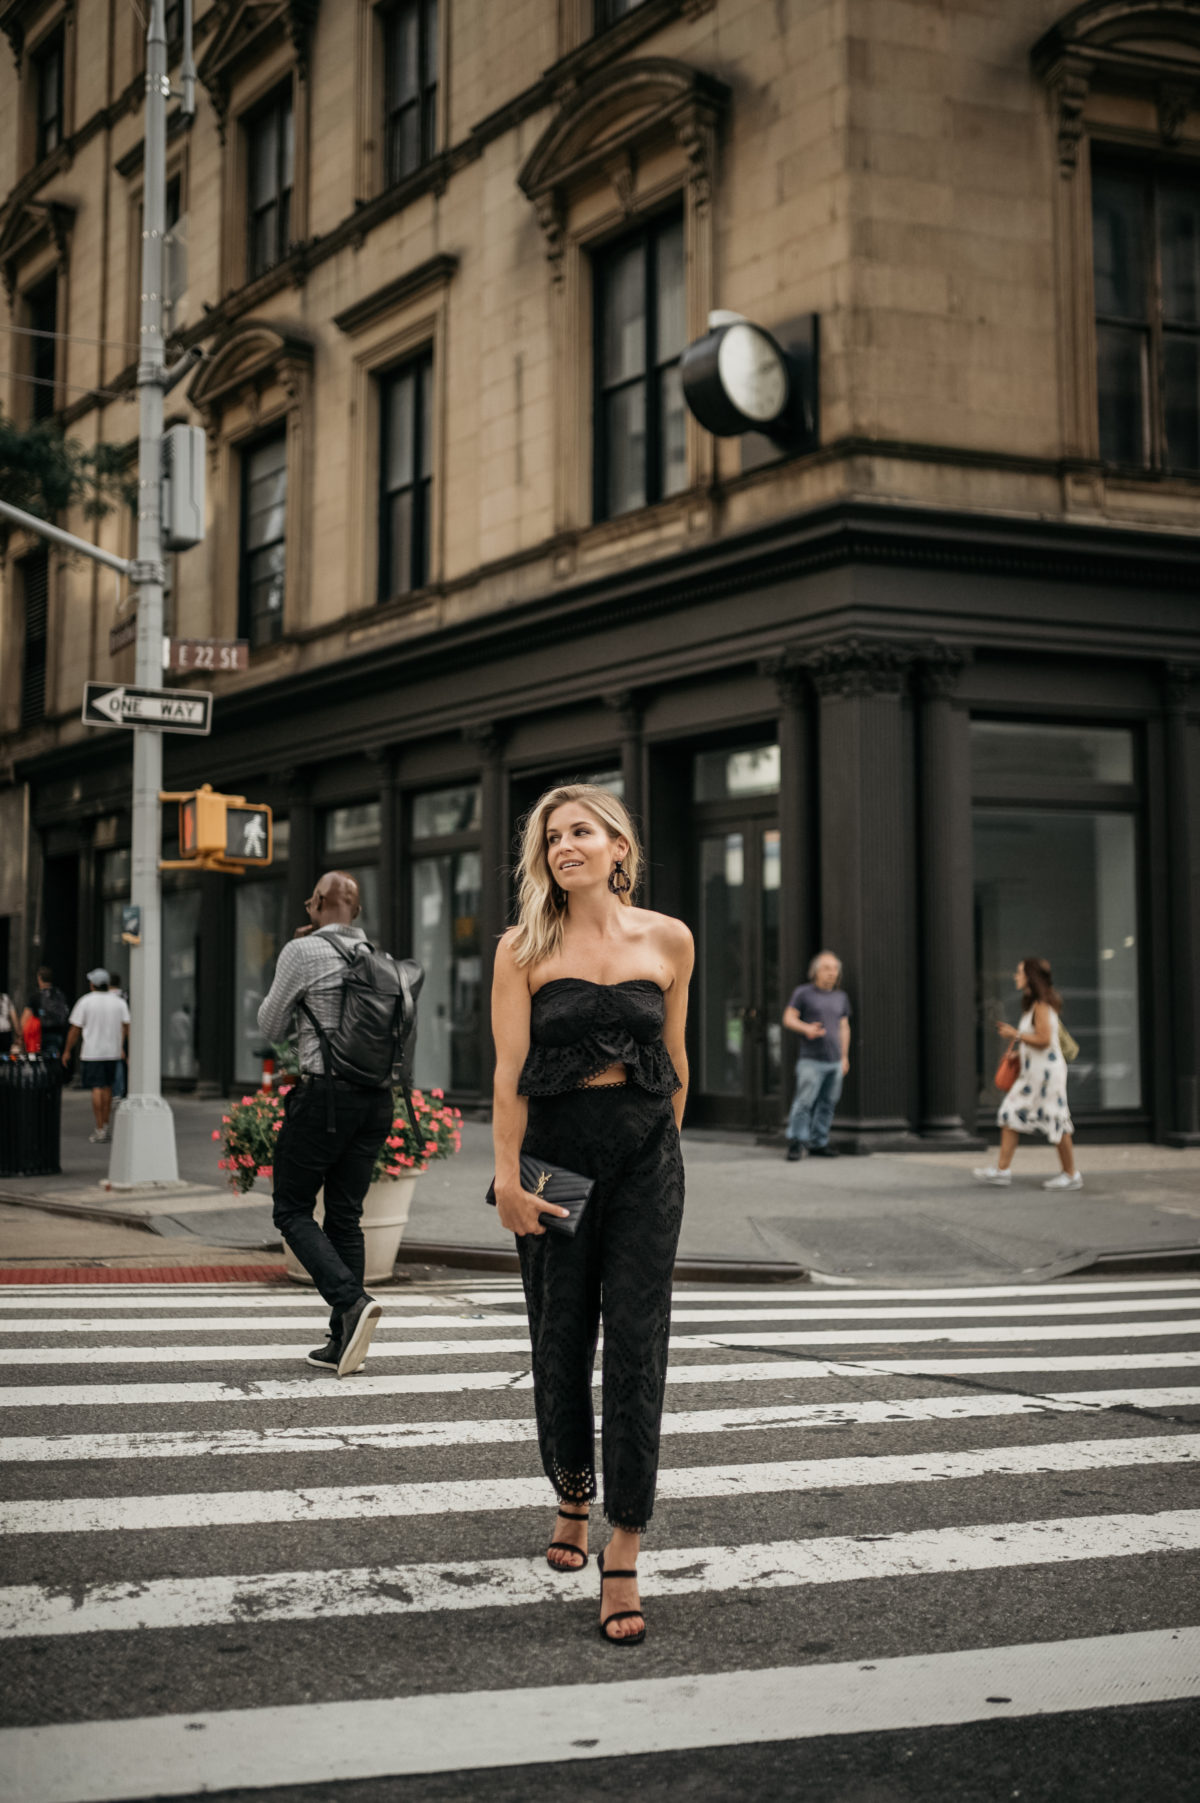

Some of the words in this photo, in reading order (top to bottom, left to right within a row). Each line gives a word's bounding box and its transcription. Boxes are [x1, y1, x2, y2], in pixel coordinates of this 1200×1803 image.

[178, 646, 188, 666] E
[194, 646, 214, 668] 22
[220, 647, 239, 669] St
[109, 697, 142, 716] ONE
[160, 700, 196, 718] WAY
